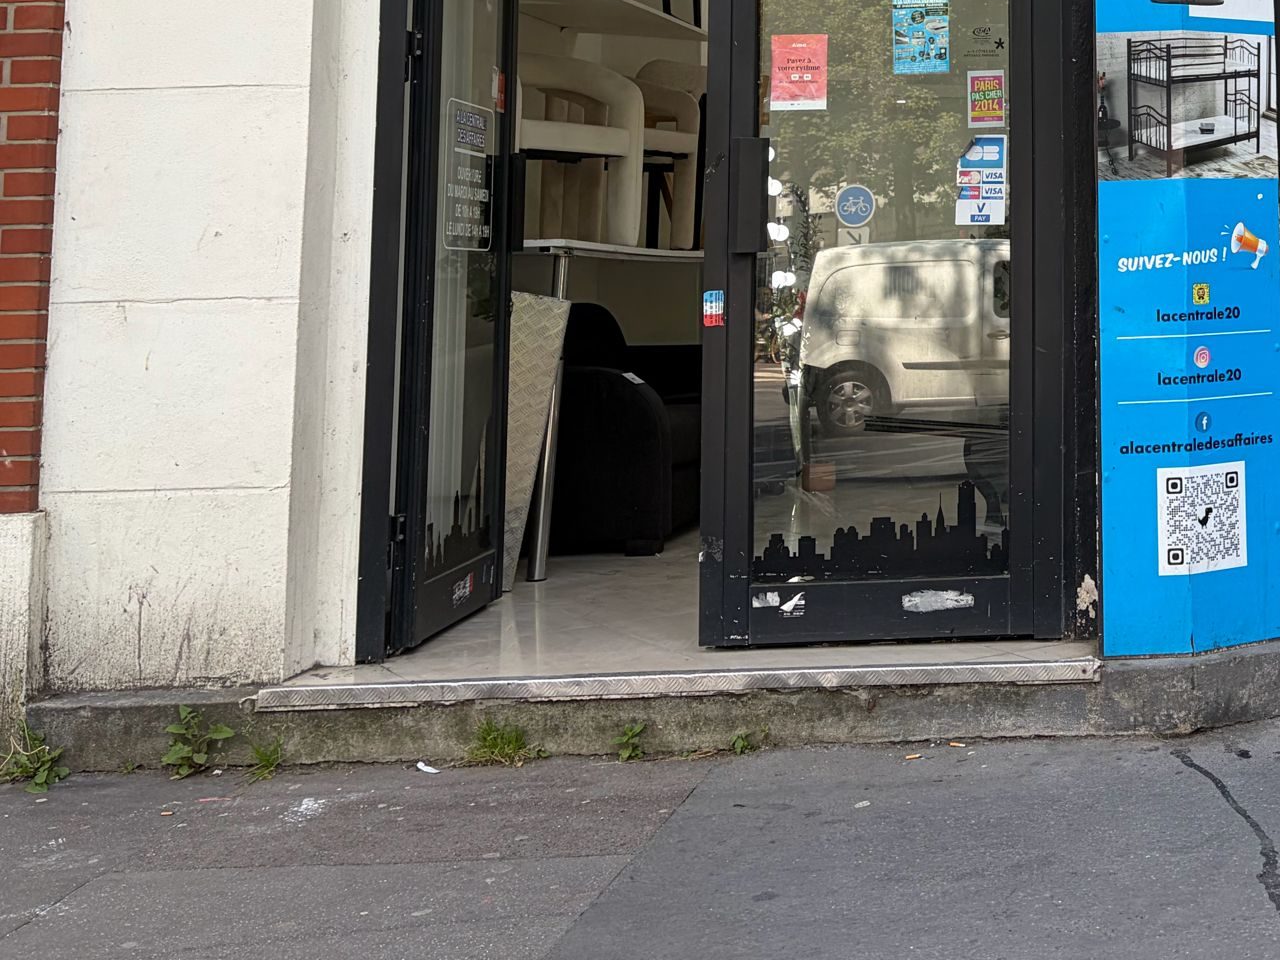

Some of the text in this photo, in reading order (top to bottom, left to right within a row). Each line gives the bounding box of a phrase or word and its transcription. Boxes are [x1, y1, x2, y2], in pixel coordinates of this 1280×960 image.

[974, 80, 999, 91] PARIS
[971, 89, 1002, 101] PAS CHER
[975, 100, 999, 111] 2014
[985, 172, 1003, 180] VISA
[985, 188, 1003, 196] VISA
[976, 202, 986, 213] V
[1117, 247, 1227, 273] SUIVEZ-NOUS !
[1156, 307, 1240, 323] lacentrale20
[1157, 369, 1242, 386] lacentrale20
[1119, 432, 1273, 455] alacentraledesaffaires
